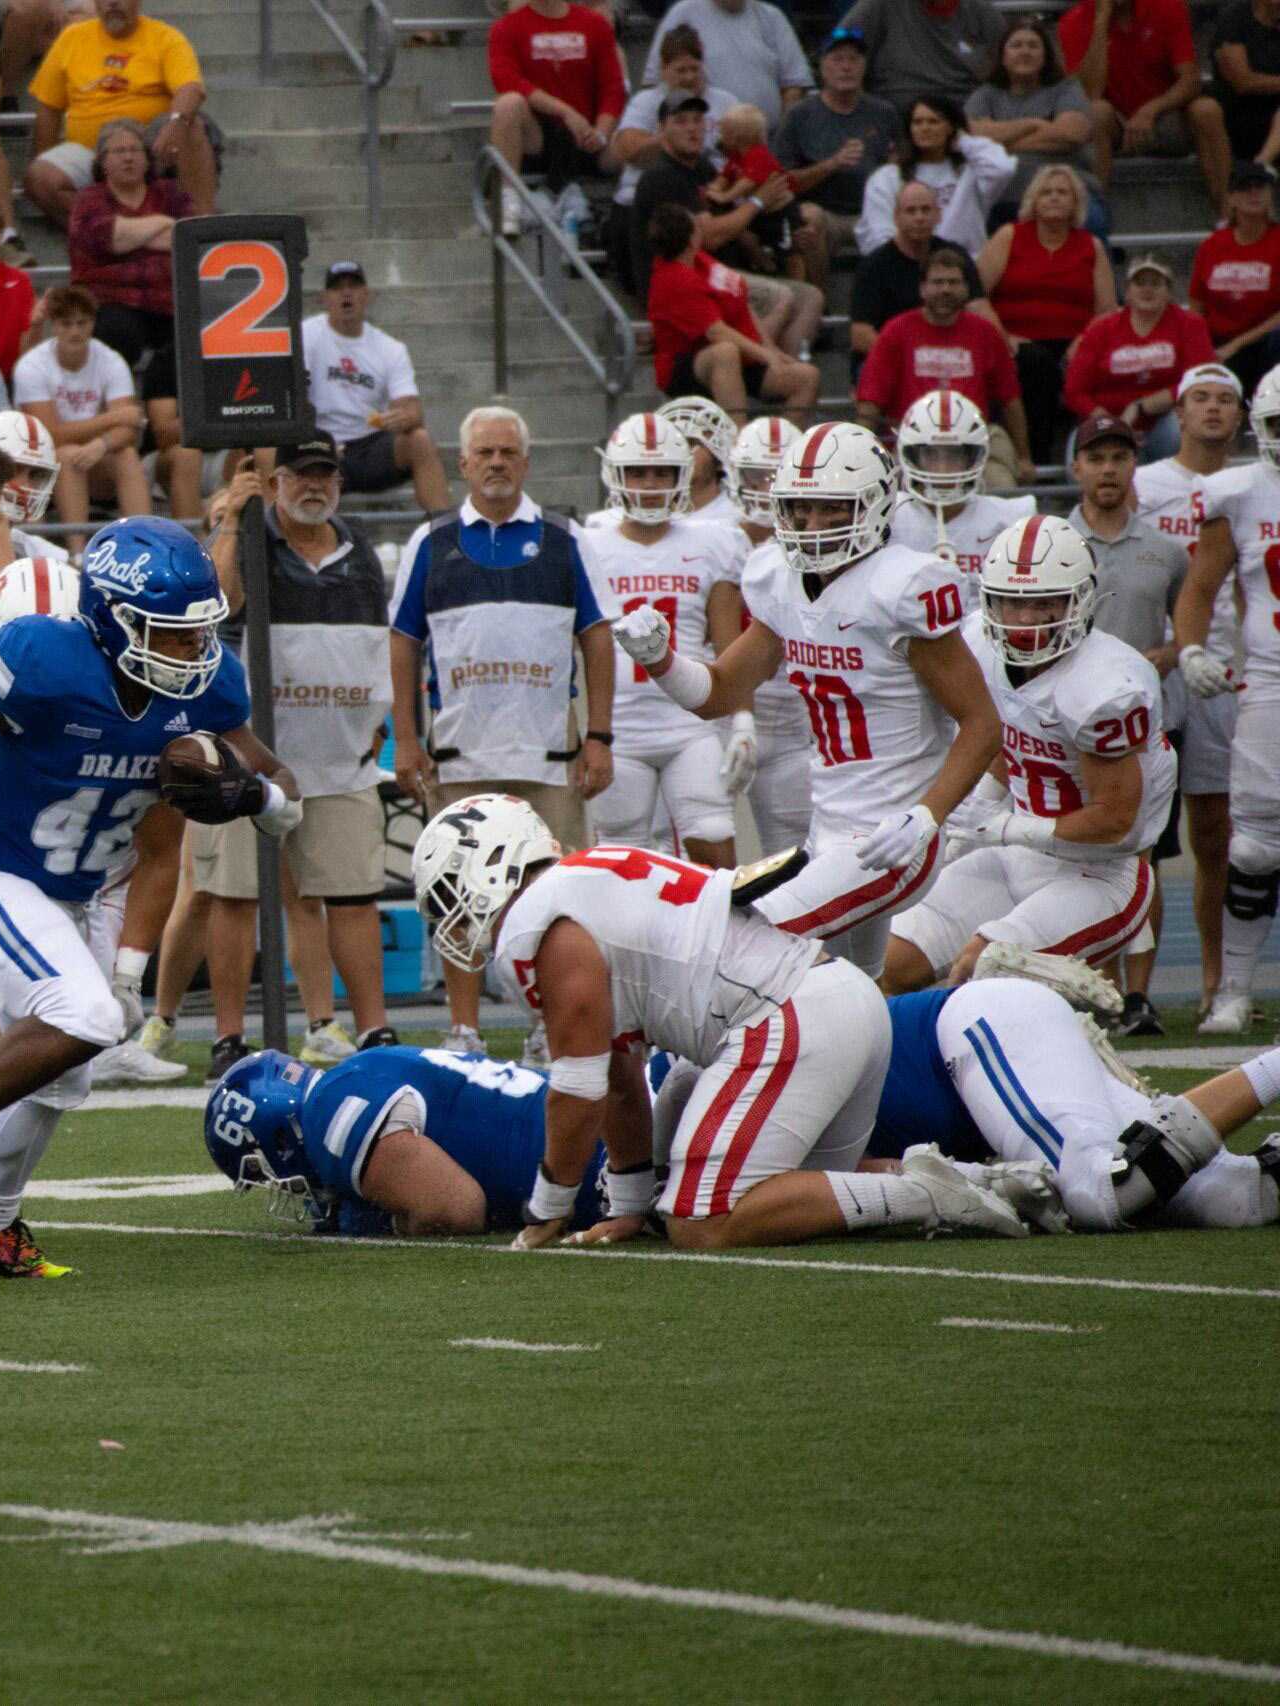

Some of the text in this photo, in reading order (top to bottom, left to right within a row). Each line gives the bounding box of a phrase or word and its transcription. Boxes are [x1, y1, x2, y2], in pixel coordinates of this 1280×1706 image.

[198, 241, 293, 360] 2
[86, 540, 151, 593] Drake
[608, 575, 699, 594] AIDERS
[918, 583, 963, 631] 10
[450, 657, 554, 689] pioneer
[788, 670, 873, 767] 10
[1094, 706, 1149, 752] 20
[78, 754, 160, 779] DRAKE
[31, 787, 160, 876] 42
